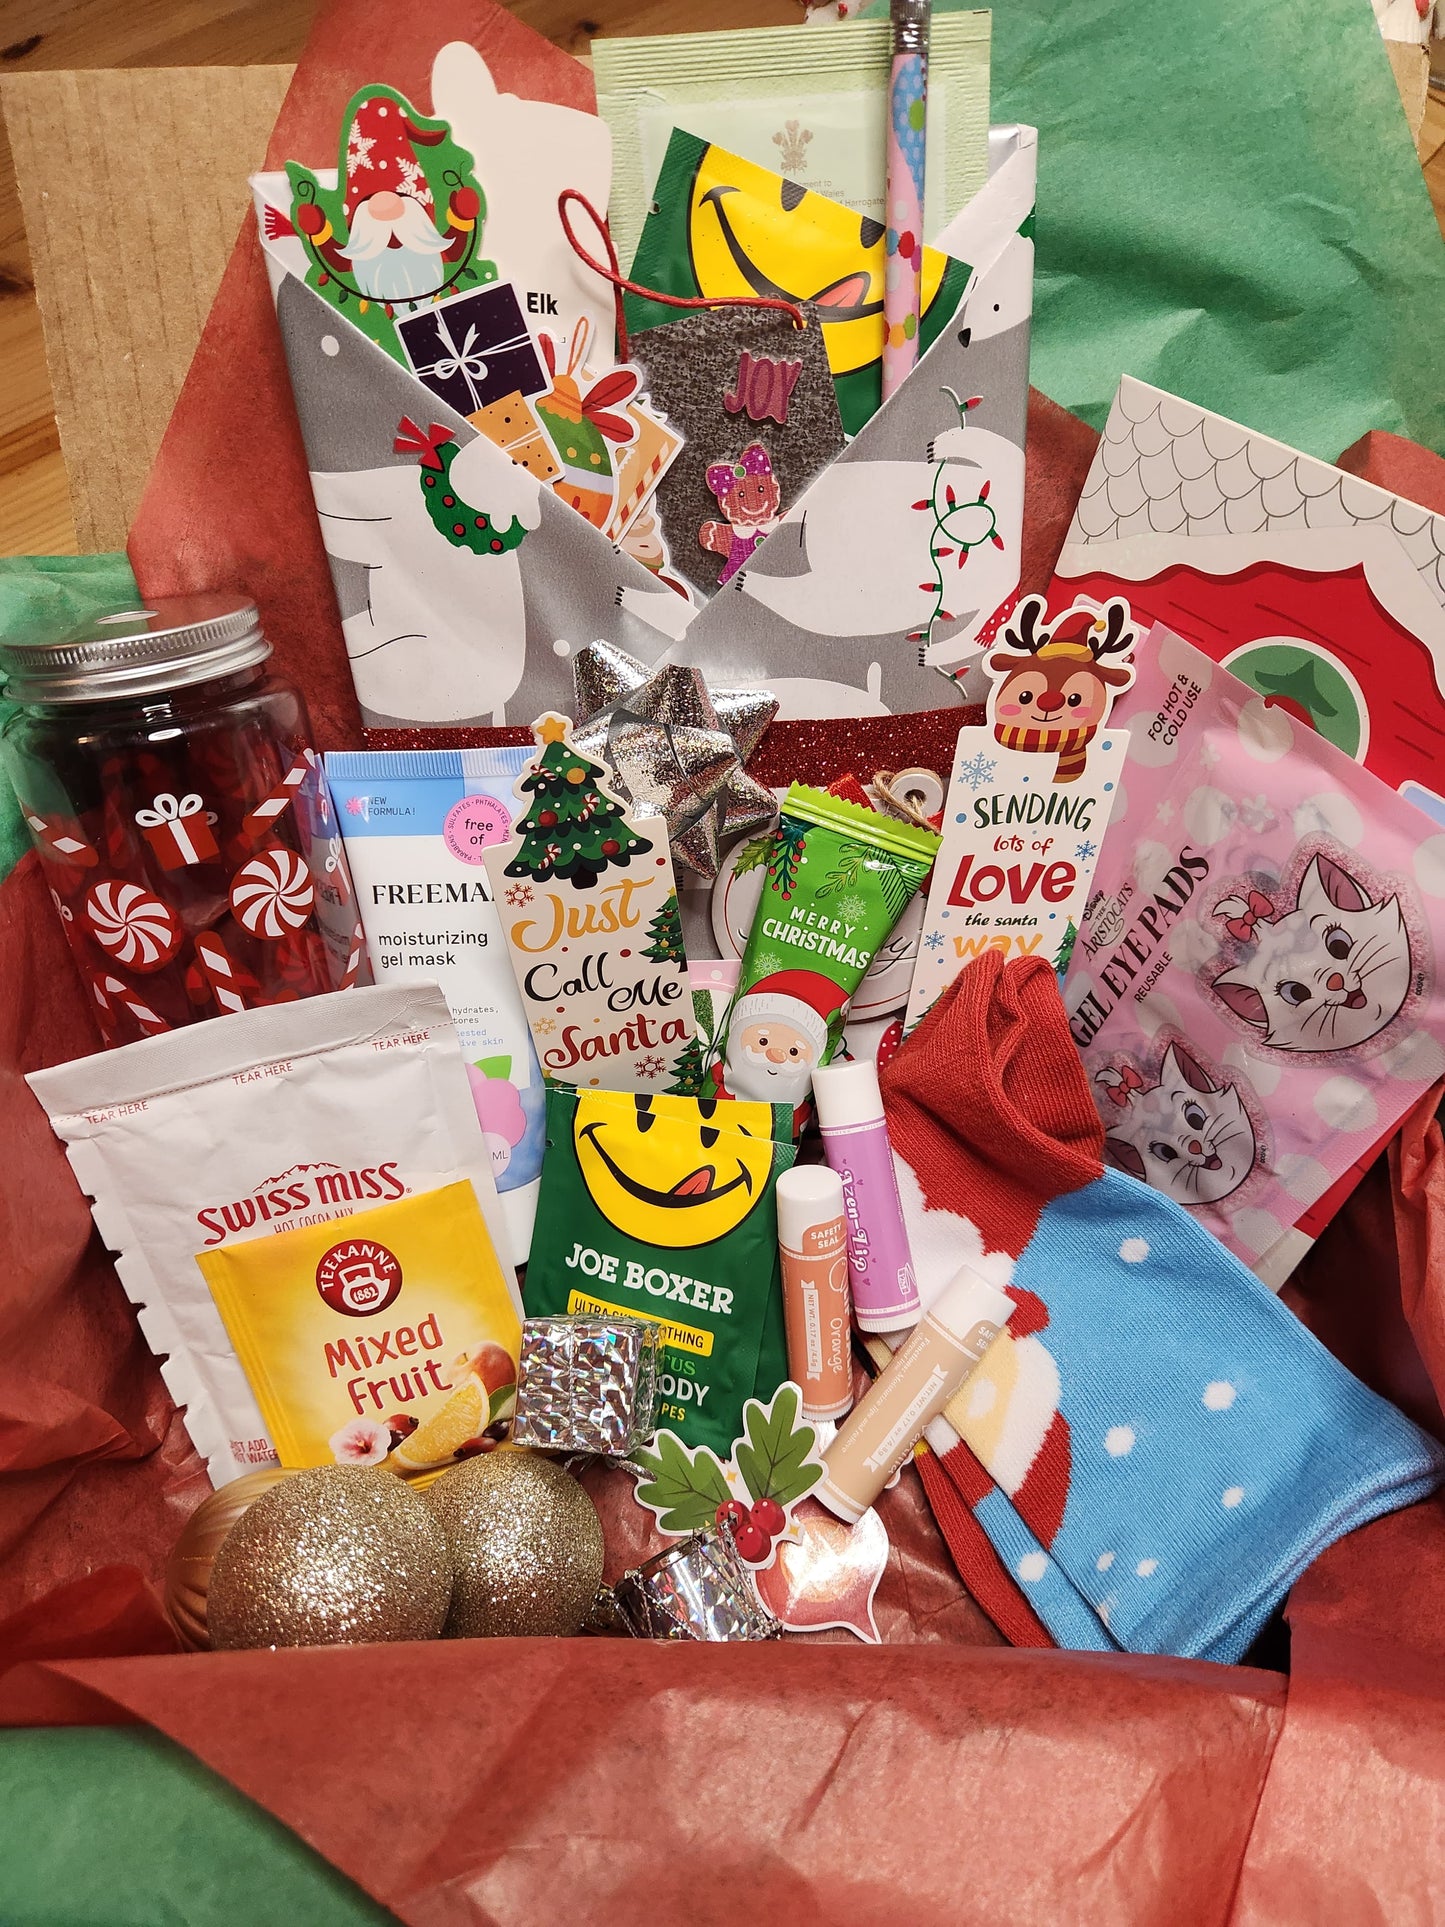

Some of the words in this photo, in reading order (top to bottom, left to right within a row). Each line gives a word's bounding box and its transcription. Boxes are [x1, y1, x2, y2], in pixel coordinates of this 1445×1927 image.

[527, 292, 559, 316] Elk
[724, 350, 802, 424] JOY
[1147, 712, 1168, 741] FOR
[1163, 682, 1183, 714] HOT
[1177, 674, 1189, 685] &
[1163, 709, 1187, 745] COLD
[1183, 681, 1202, 709] USE
[368, 807, 416, 816] FORMULA!
[448, 801, 472, 830] SULFATES
[475, 799, 509, 824] PHTHALATES
[974, 792, 1097, 832] SENDING
[465, 819, 494, 832] free
[447, 834, 473, 861] PARABENS
[470, 834, 485, 845] of
[993, 834, 1025, 852] lots
[1031, 837, 1054, 856] of
[946, 854, 1077, 908] Love
[372, 882, 495, 905] FREEMA
[510, 876, 656, 953] Just
[789, 905, 856, 939] MERRY
[965, 912, 990, 926] the
[994, 914, 1038, 927] santa
[1081, 882, 1133, 961] ARISTOCATS
[1096, 906, 1106, 920] THE
[378, 930, 488, 947] moisturizing
[1068, 990, 1114, 1048] GEL
[1100, 928, 1153, 1000] EYE
[1137, 845, 1209, 944] PADS
[381, 952, 403, 969] gel
[409, 951, 456, 966] mask
[524, 952, 614, 1002] Call
[607, 975, 683, 1012] Me
[1134, 951, 1173, 1004] REUSABLE
[452, 1006, 499, 1015] hydrates,
[372, 1037, 400, 1052] TEAR
[403, 1031, 430, 1046] HERE
[482, 1037, 504, 1046] skin
[544, 1013, 692, 1069] Santa
[233, 1071, 262, 1086] TEAR
[264, 1062, 293, 1079] HERE
[86, 1110, 116, 1125] TEAR
[118, 1101, 149, 1117] HERE
[492, 1150, 508, 1160] ML
[197, 1182, 311, 1246] SWISS
[810, 1222, 842, 1240] SAFETY
[817, 1235, 839, 1249] SEAL
[320, 1244, 397, 1292] TEEKANNE
[565, 1242, 620, 1284] JOE
[623, 1261, 734, 1315] BOXER
[353, 1286, 379, 1302] 1882
[324, 1313, 444, 1378] Mixed
[661, 1326, 705, 1349] THING
[825, 1317, 846, 1375] Orange
[347, 1359, 453, 1416] Fruit
[661, 1374, 710, 1407] ODY
[661, 1402, 686, 1421] PES
[248, 1439, 268, 1451] ADD
